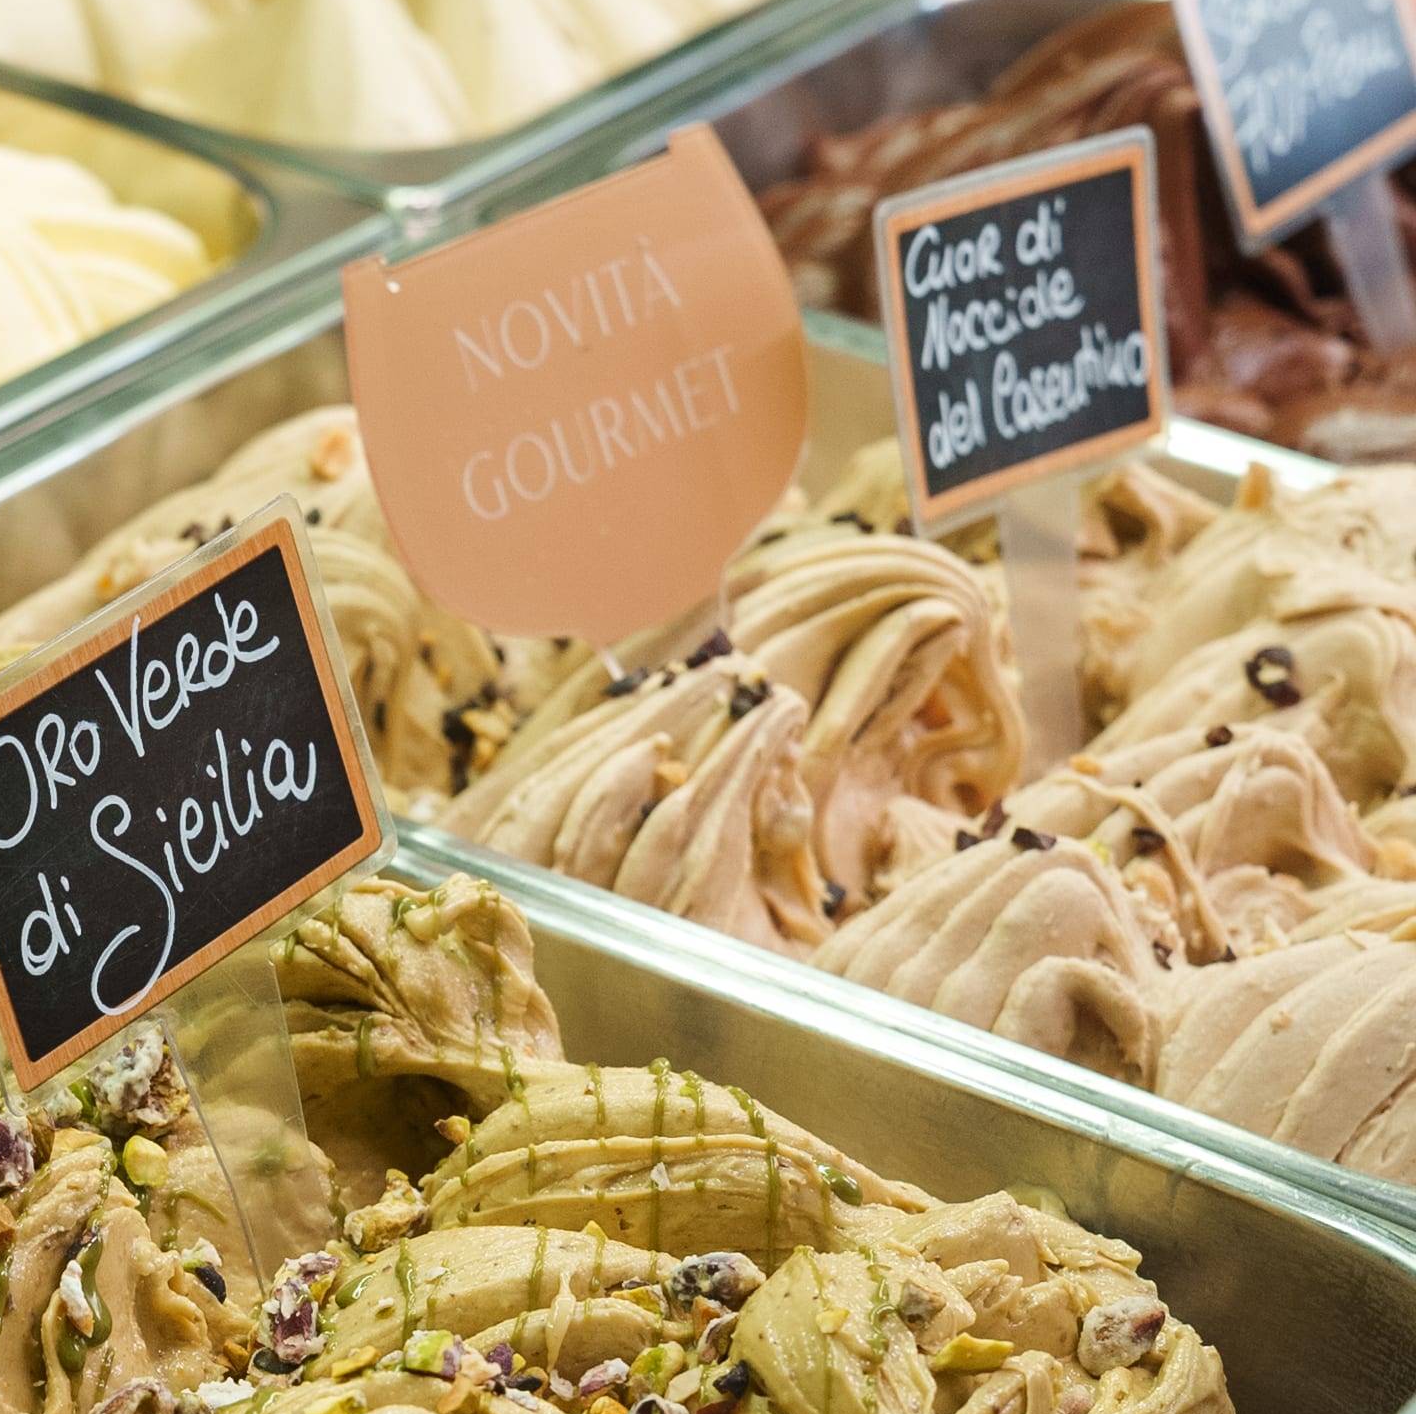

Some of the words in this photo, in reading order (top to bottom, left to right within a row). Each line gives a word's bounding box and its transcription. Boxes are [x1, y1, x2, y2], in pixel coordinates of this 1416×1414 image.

[1016, 195, 1066, 266] di
[453, 235, 682, 394] NOVITÀ
[461, 345, 743, 521] GOURMET
[929, 379, 986, 470] del
[21, 872, 82, 976] di
[90, 728, 317, 1017] Sicilia
